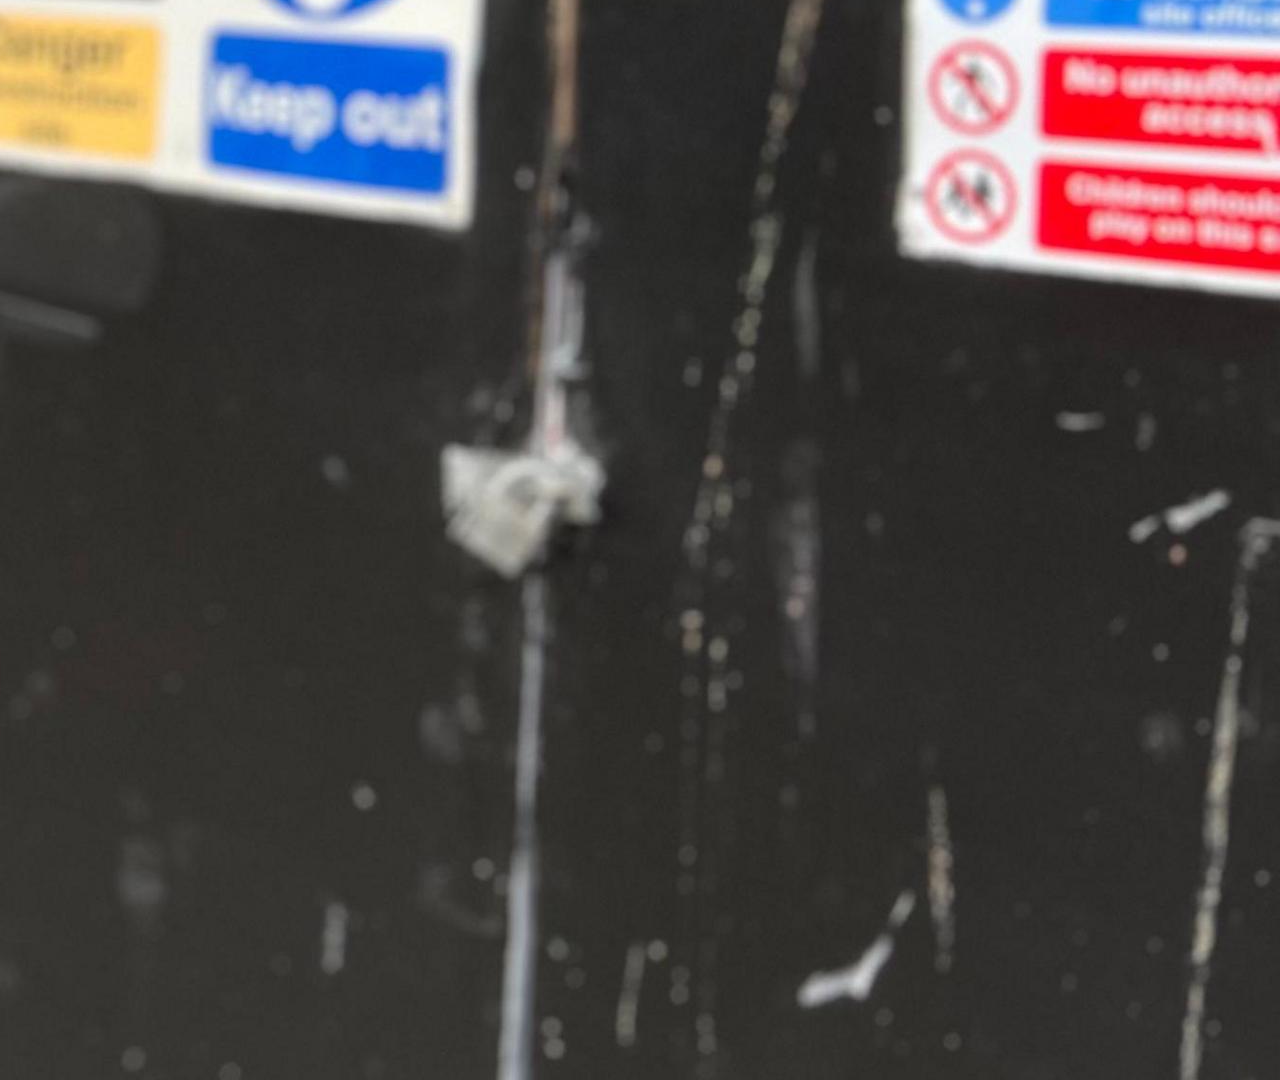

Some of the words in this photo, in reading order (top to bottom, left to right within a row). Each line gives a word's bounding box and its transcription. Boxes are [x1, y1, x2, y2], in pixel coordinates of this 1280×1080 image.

[1062, 55, 1117, 97] No
[210, 62, 338, 154] Keep
[340, 83, 445, 154] out
[1065, 171, 1184, 212] Children
[1088, 209, 1150, 246] play
